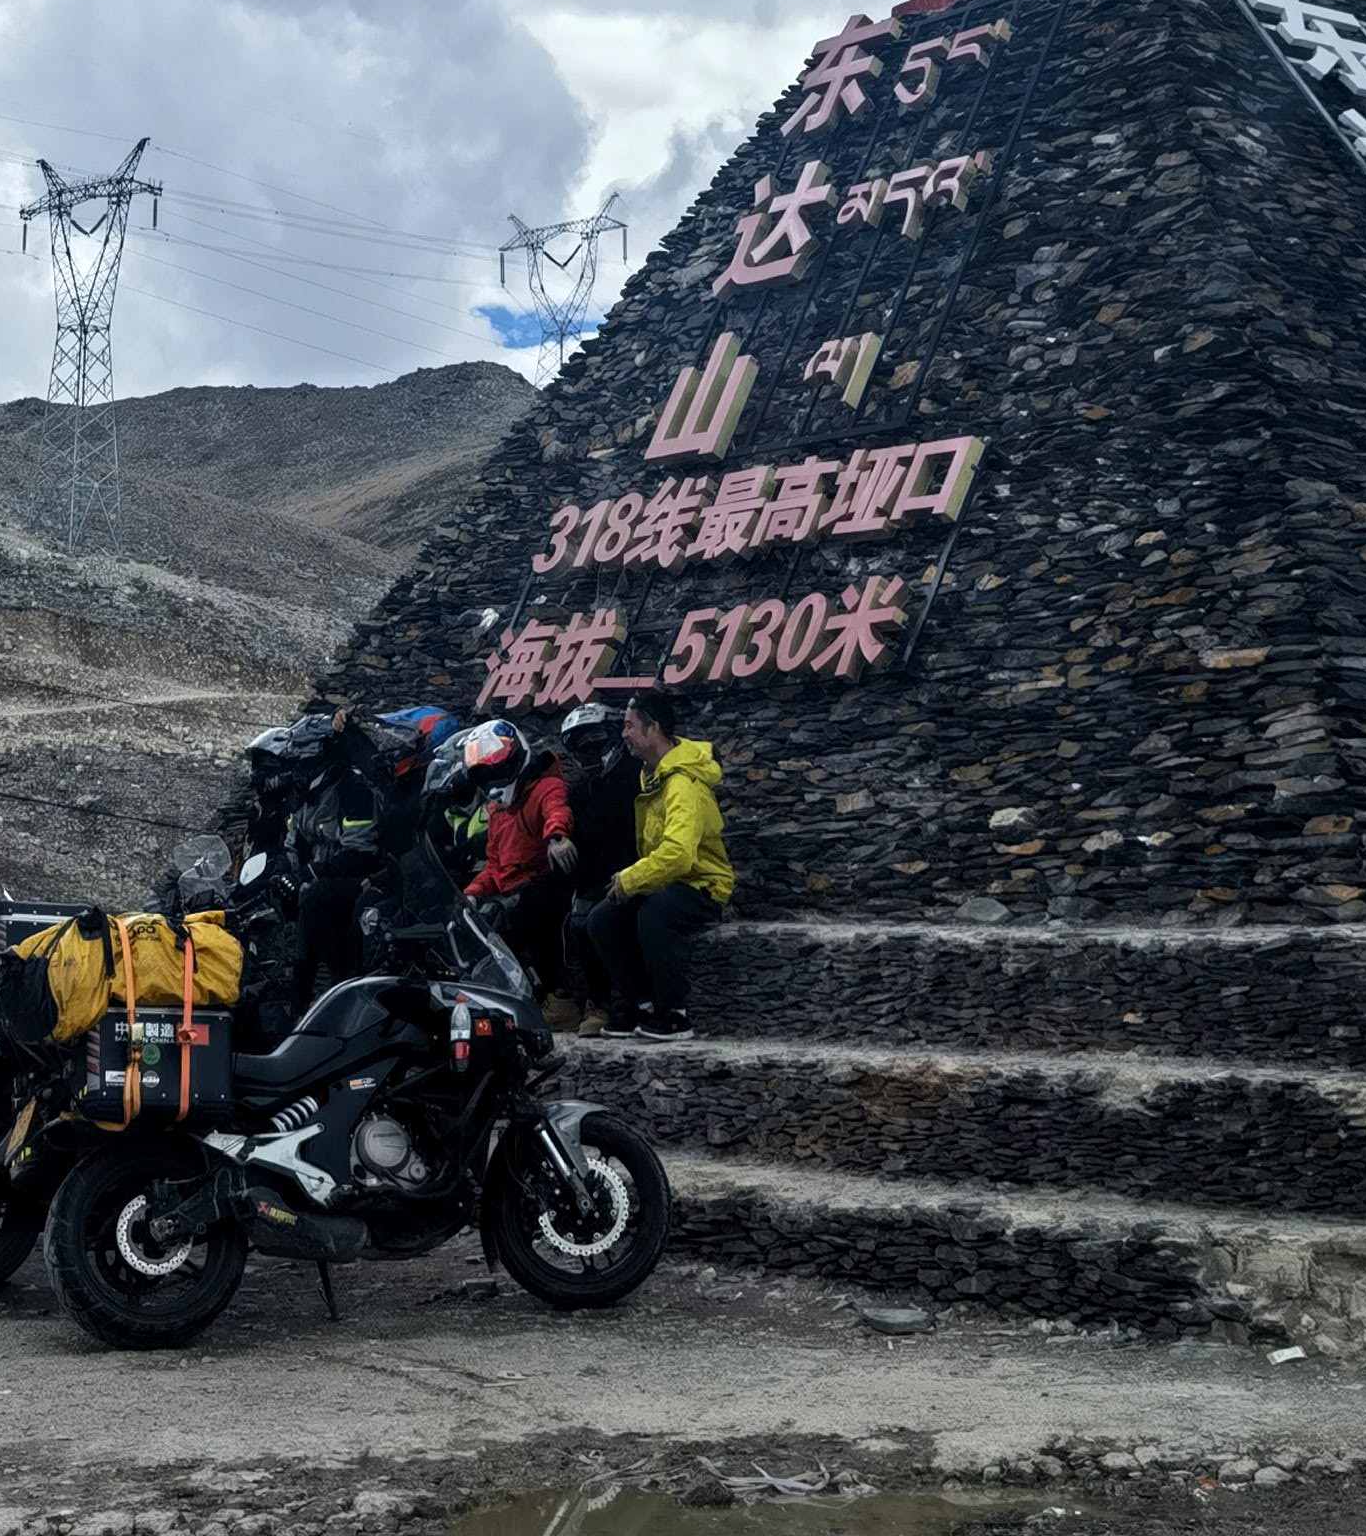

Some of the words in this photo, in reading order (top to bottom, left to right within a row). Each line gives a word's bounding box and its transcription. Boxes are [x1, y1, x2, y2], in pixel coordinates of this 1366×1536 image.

[533, 436, 985, 576] 318线最高垭口
[115, 1021, 175, 1038] 中製造
